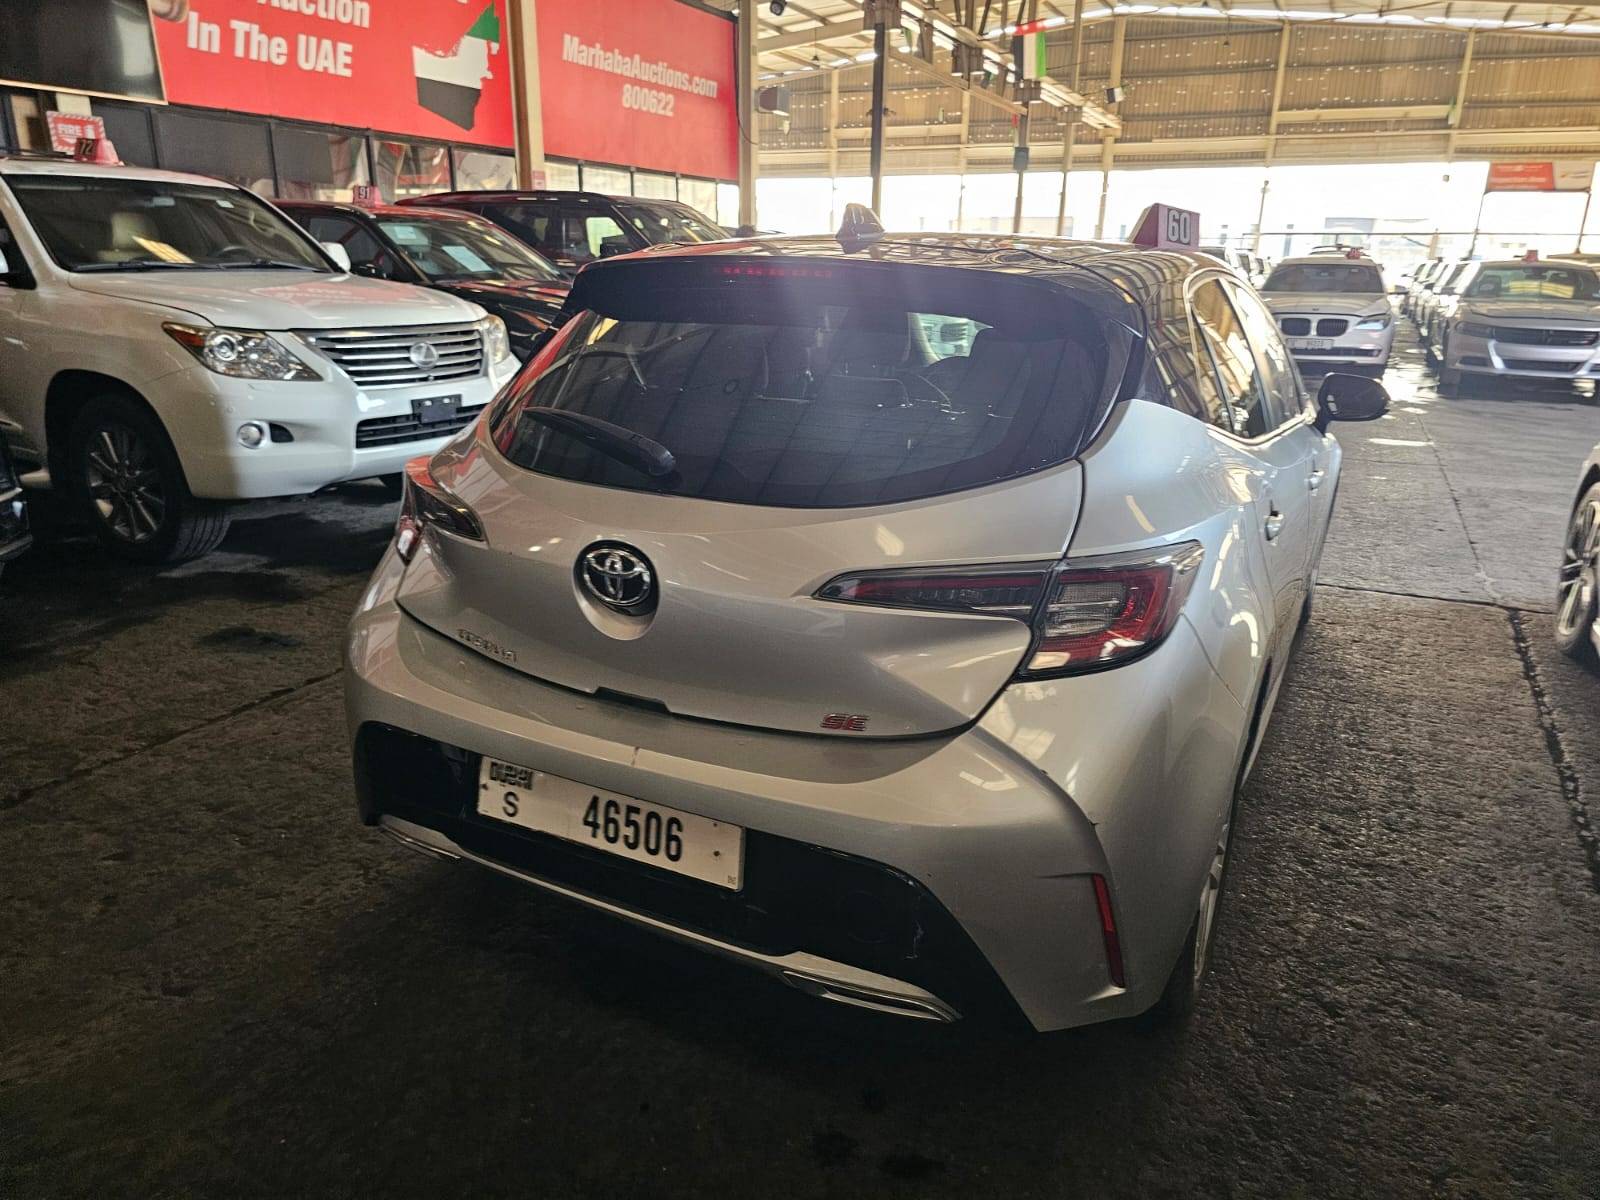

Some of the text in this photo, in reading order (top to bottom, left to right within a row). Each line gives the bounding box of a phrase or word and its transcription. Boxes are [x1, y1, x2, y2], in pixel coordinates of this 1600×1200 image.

[257, 0, 370, 28] ction
[186, 11, 353, 78] In The UAE
[562, 33, 718, 98] MarhabaAuctions.com
[622, 83, 675, 117] 800622
[1168, 209, 1191, 245] 60
[820, 712, 870, 731] SE
[502, 791, 684, 862] S 46506
